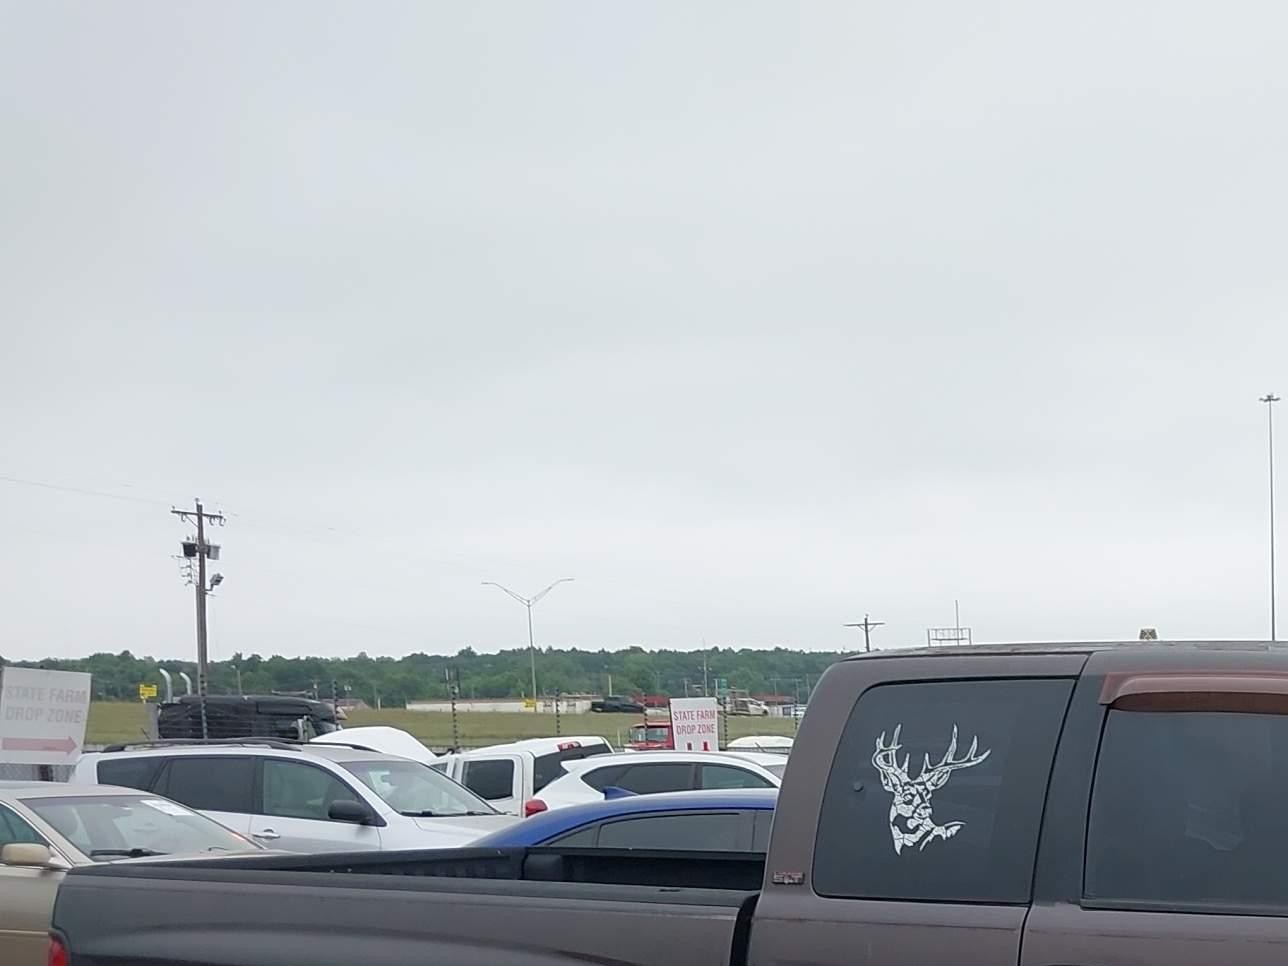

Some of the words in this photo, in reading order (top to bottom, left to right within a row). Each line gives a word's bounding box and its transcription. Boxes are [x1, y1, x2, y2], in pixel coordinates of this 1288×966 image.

[6, 686, 46, 701] STATE
[49, 687, 87, 704] FARM
[5, 706, 44, 721] DROP
[47, 709, 83, 723] ZONE
[673, 711, 695, 720] STATE
[697, 710, 715, 719] FARM
[676, 725, 696, 735] DROP
[698, 724, 715, 733] ZONE
